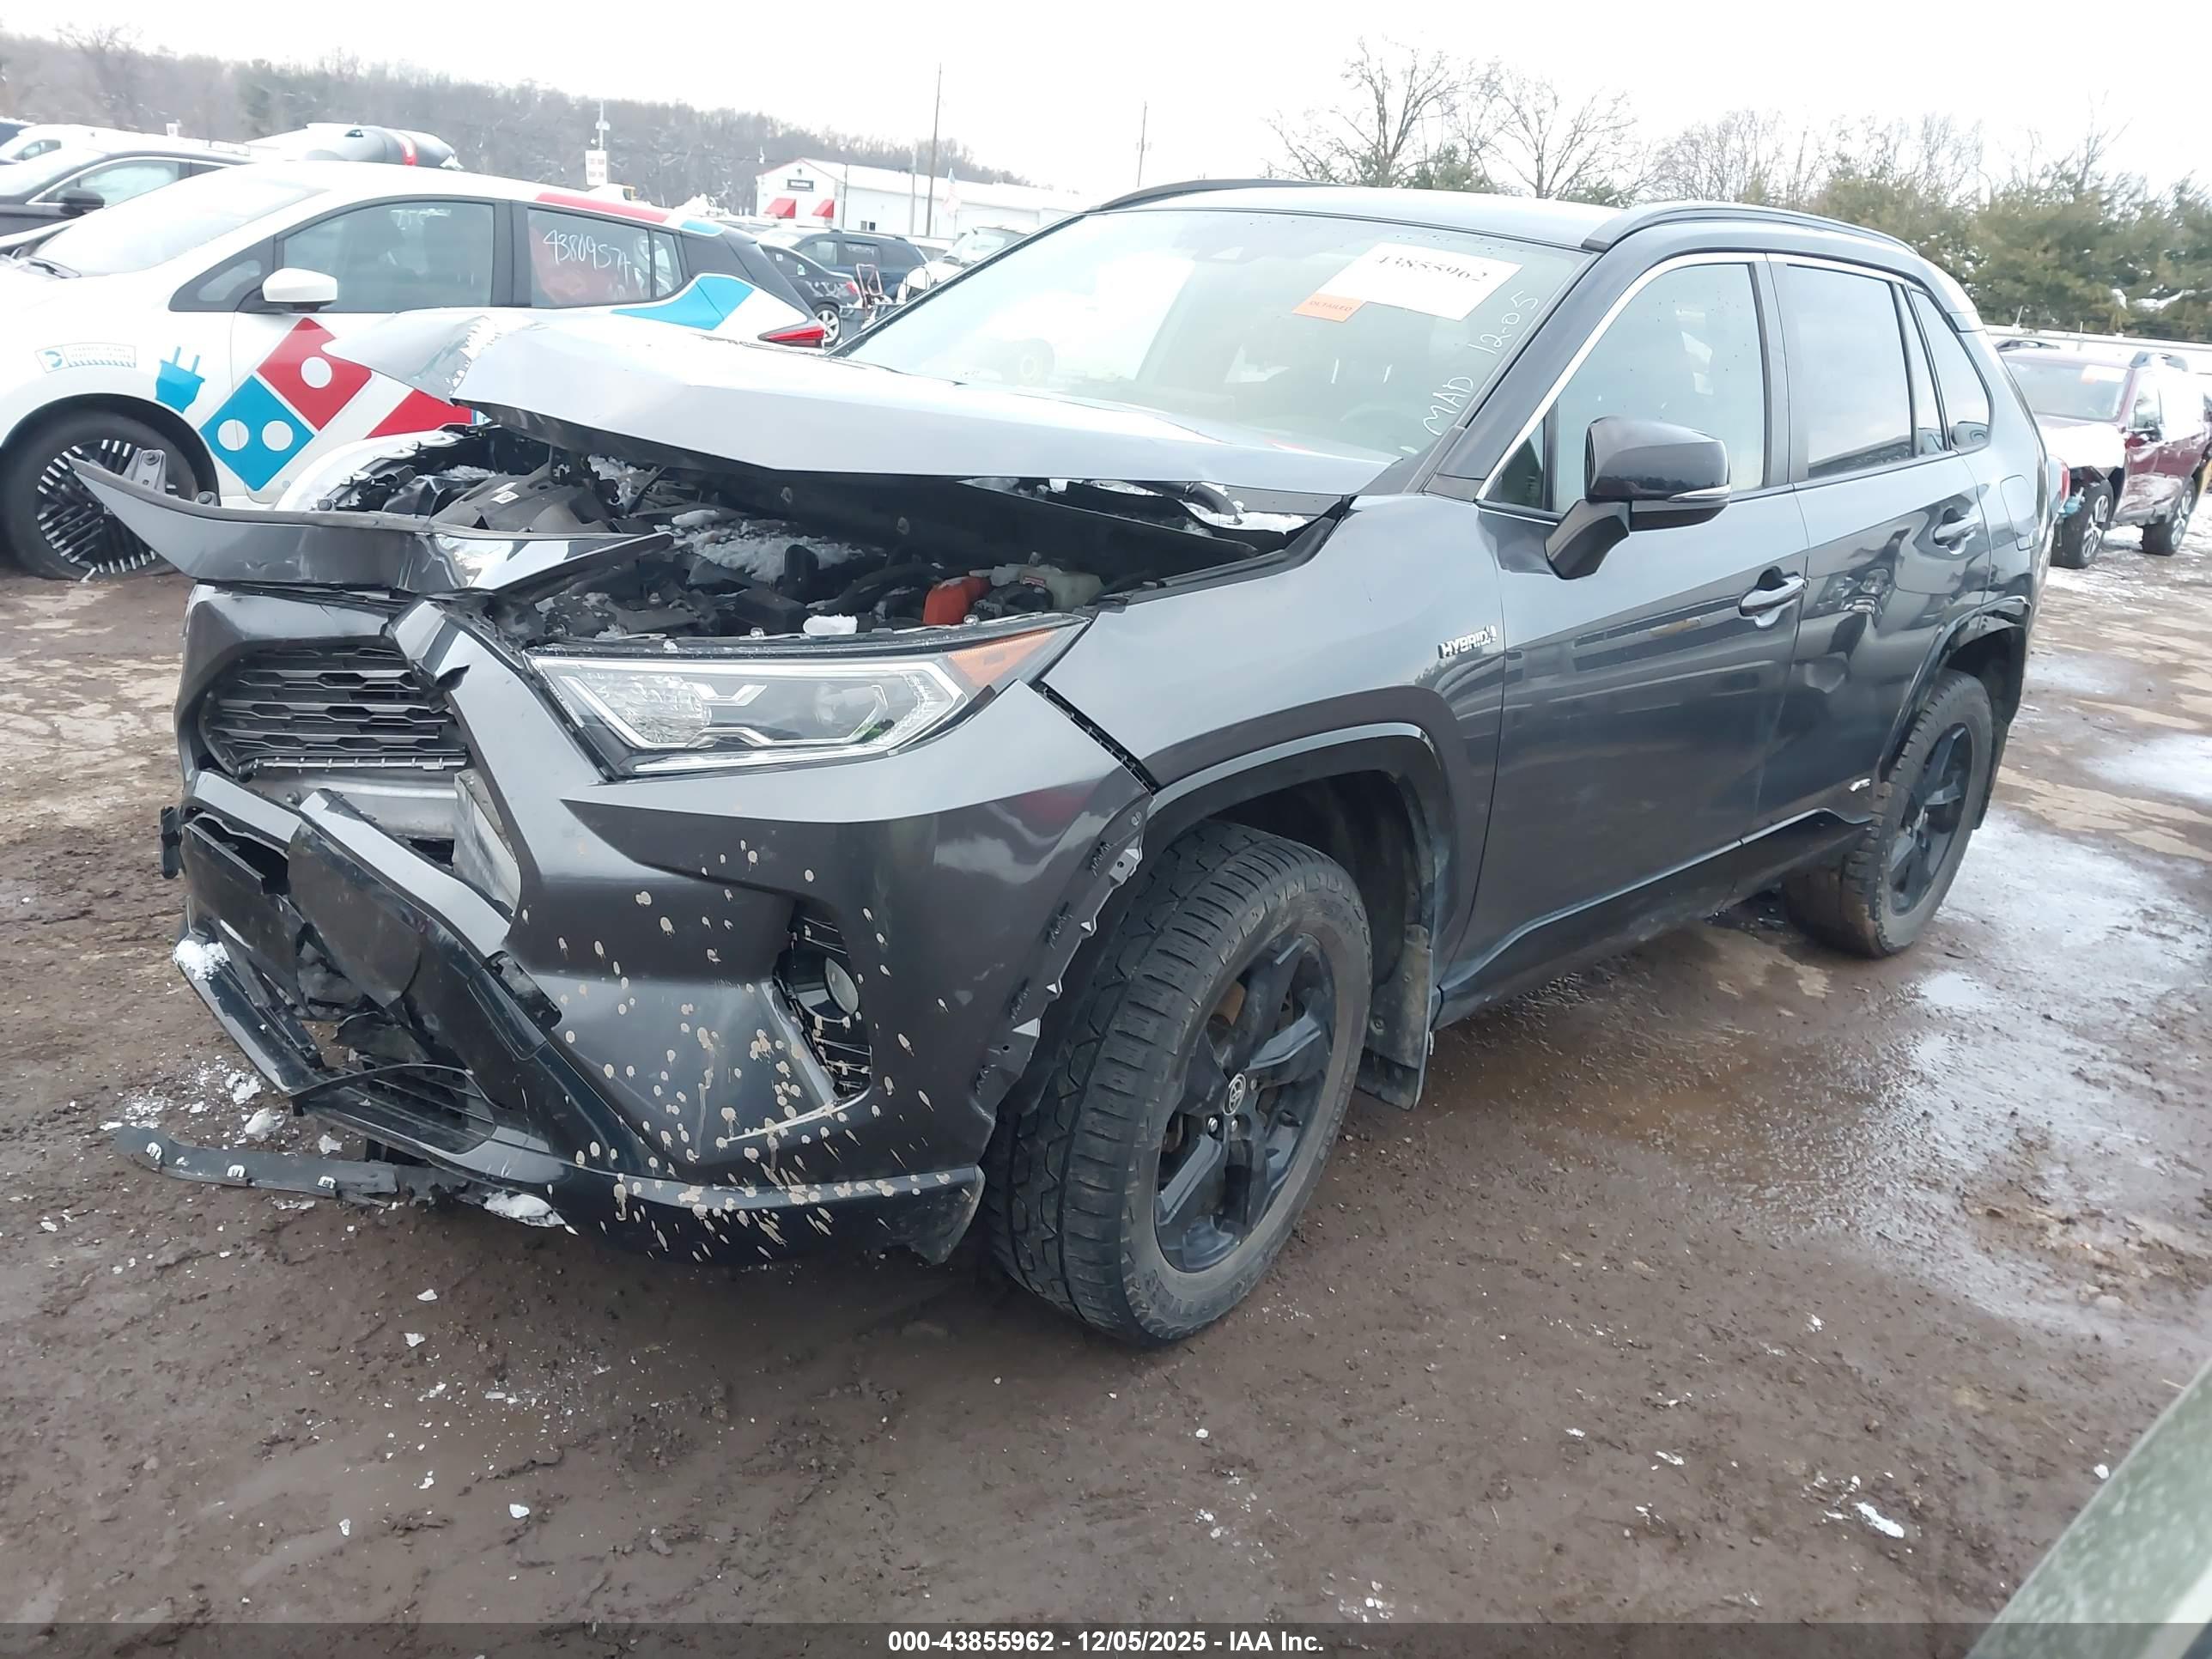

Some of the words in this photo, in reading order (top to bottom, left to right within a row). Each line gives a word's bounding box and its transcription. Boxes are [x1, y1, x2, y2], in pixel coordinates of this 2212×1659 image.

[1422, 376, 1474, 435] MAD
[1468, 290, 1539, 355] 12-05
[1437, 629, 1494, 659] HYBRID
